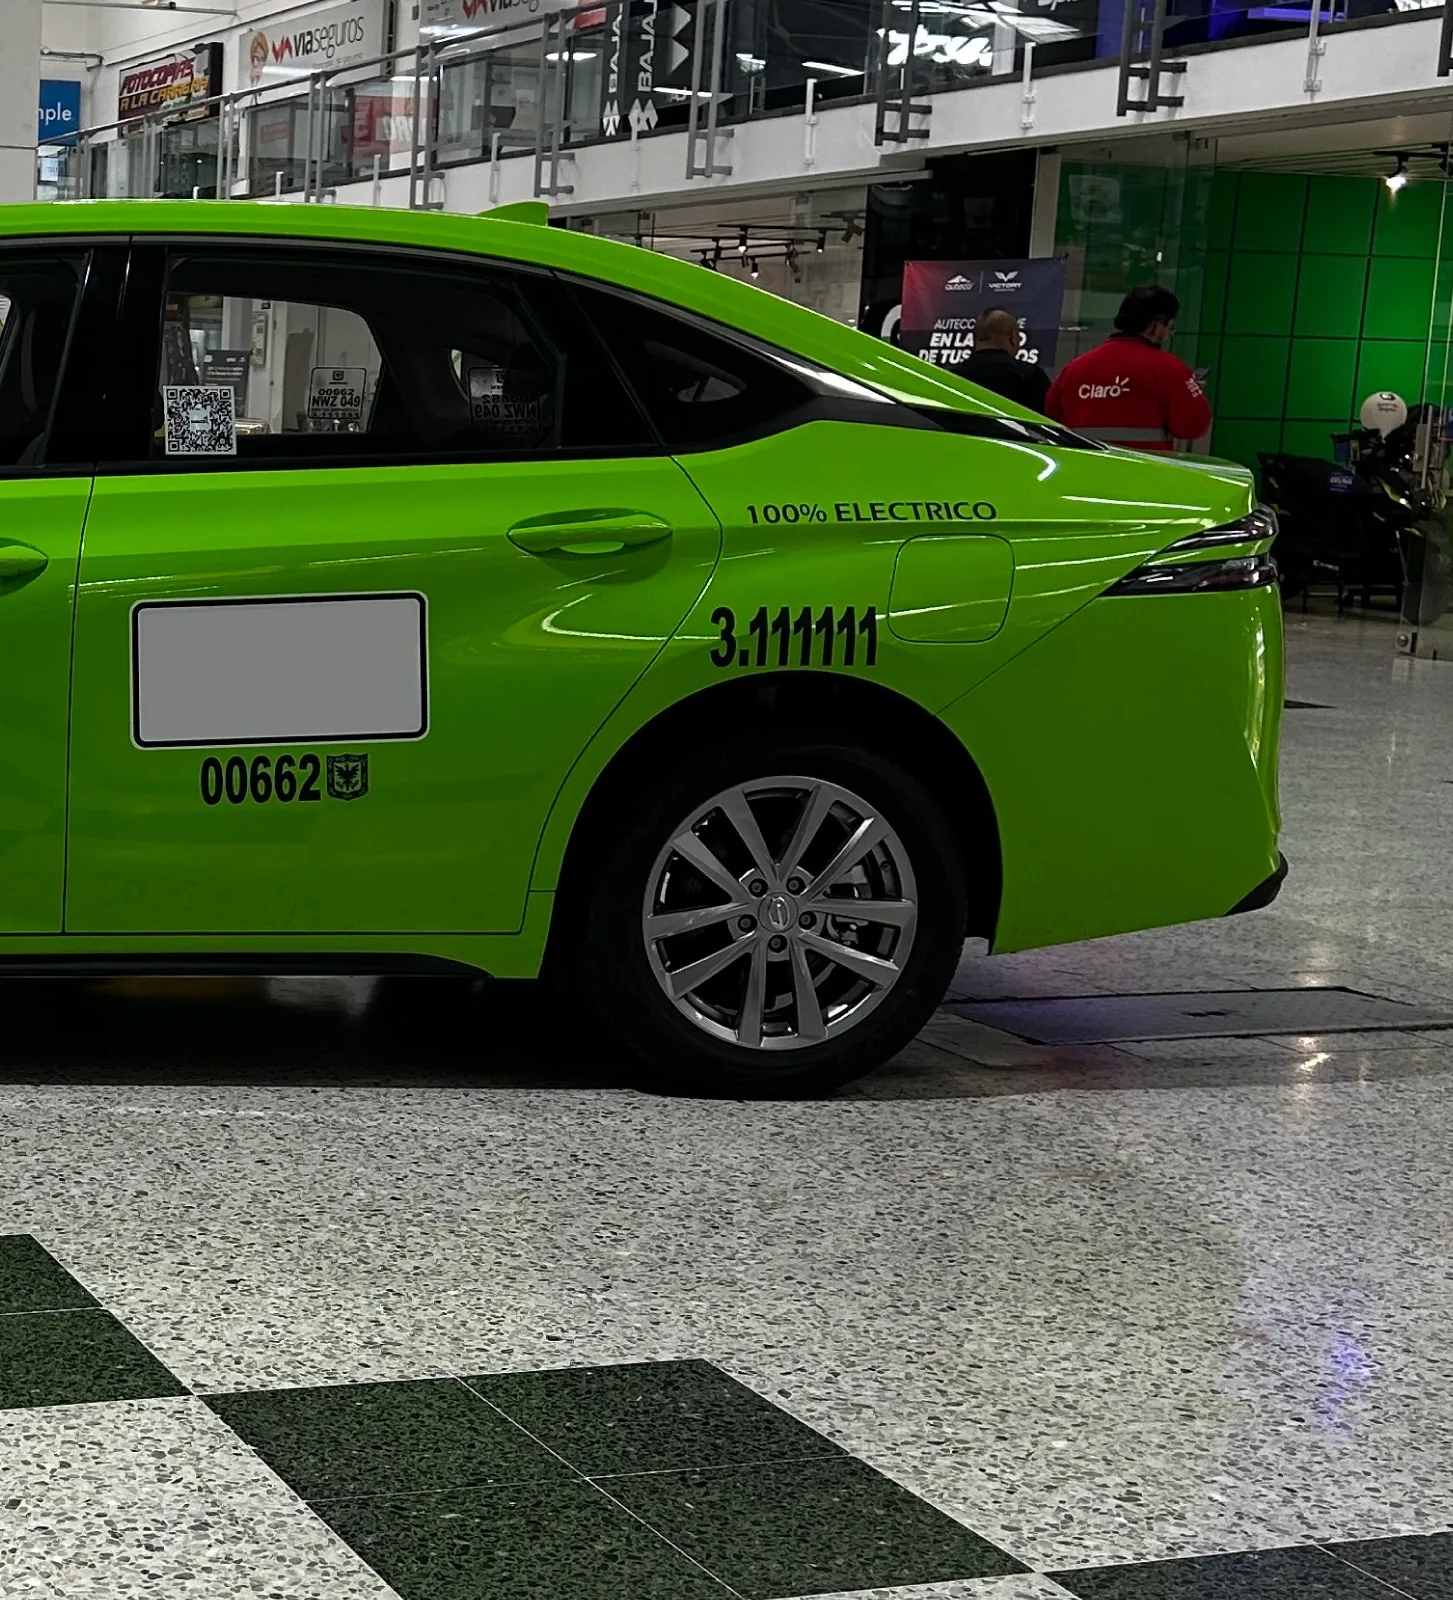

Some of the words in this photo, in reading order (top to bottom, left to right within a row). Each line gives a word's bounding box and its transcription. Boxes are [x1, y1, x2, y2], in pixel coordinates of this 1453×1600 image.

[120, 57, 197, 96] FOTOCOPIAS
[120, 98, 129, 111] A
[130, 94, 147, 109] LA
[38, 102, 73, 126] ple
[930, 332, 954, 347] EN
[954, 332, 975, 347] LA
[918, 349, 937, 364] DE
[940, 349, 972, 364] TUS
[311, 395, 338, 407] NWZ
[340, 395, 361, 407] 049
[1078, 383, 1121, 399] Claro
[747, 502, 828, 525] 100%
[834, 501, 998, 523] ELECTRICO
[709, 606, 878, 668] 3.111111
[200, 753, 322, 806] 00662
